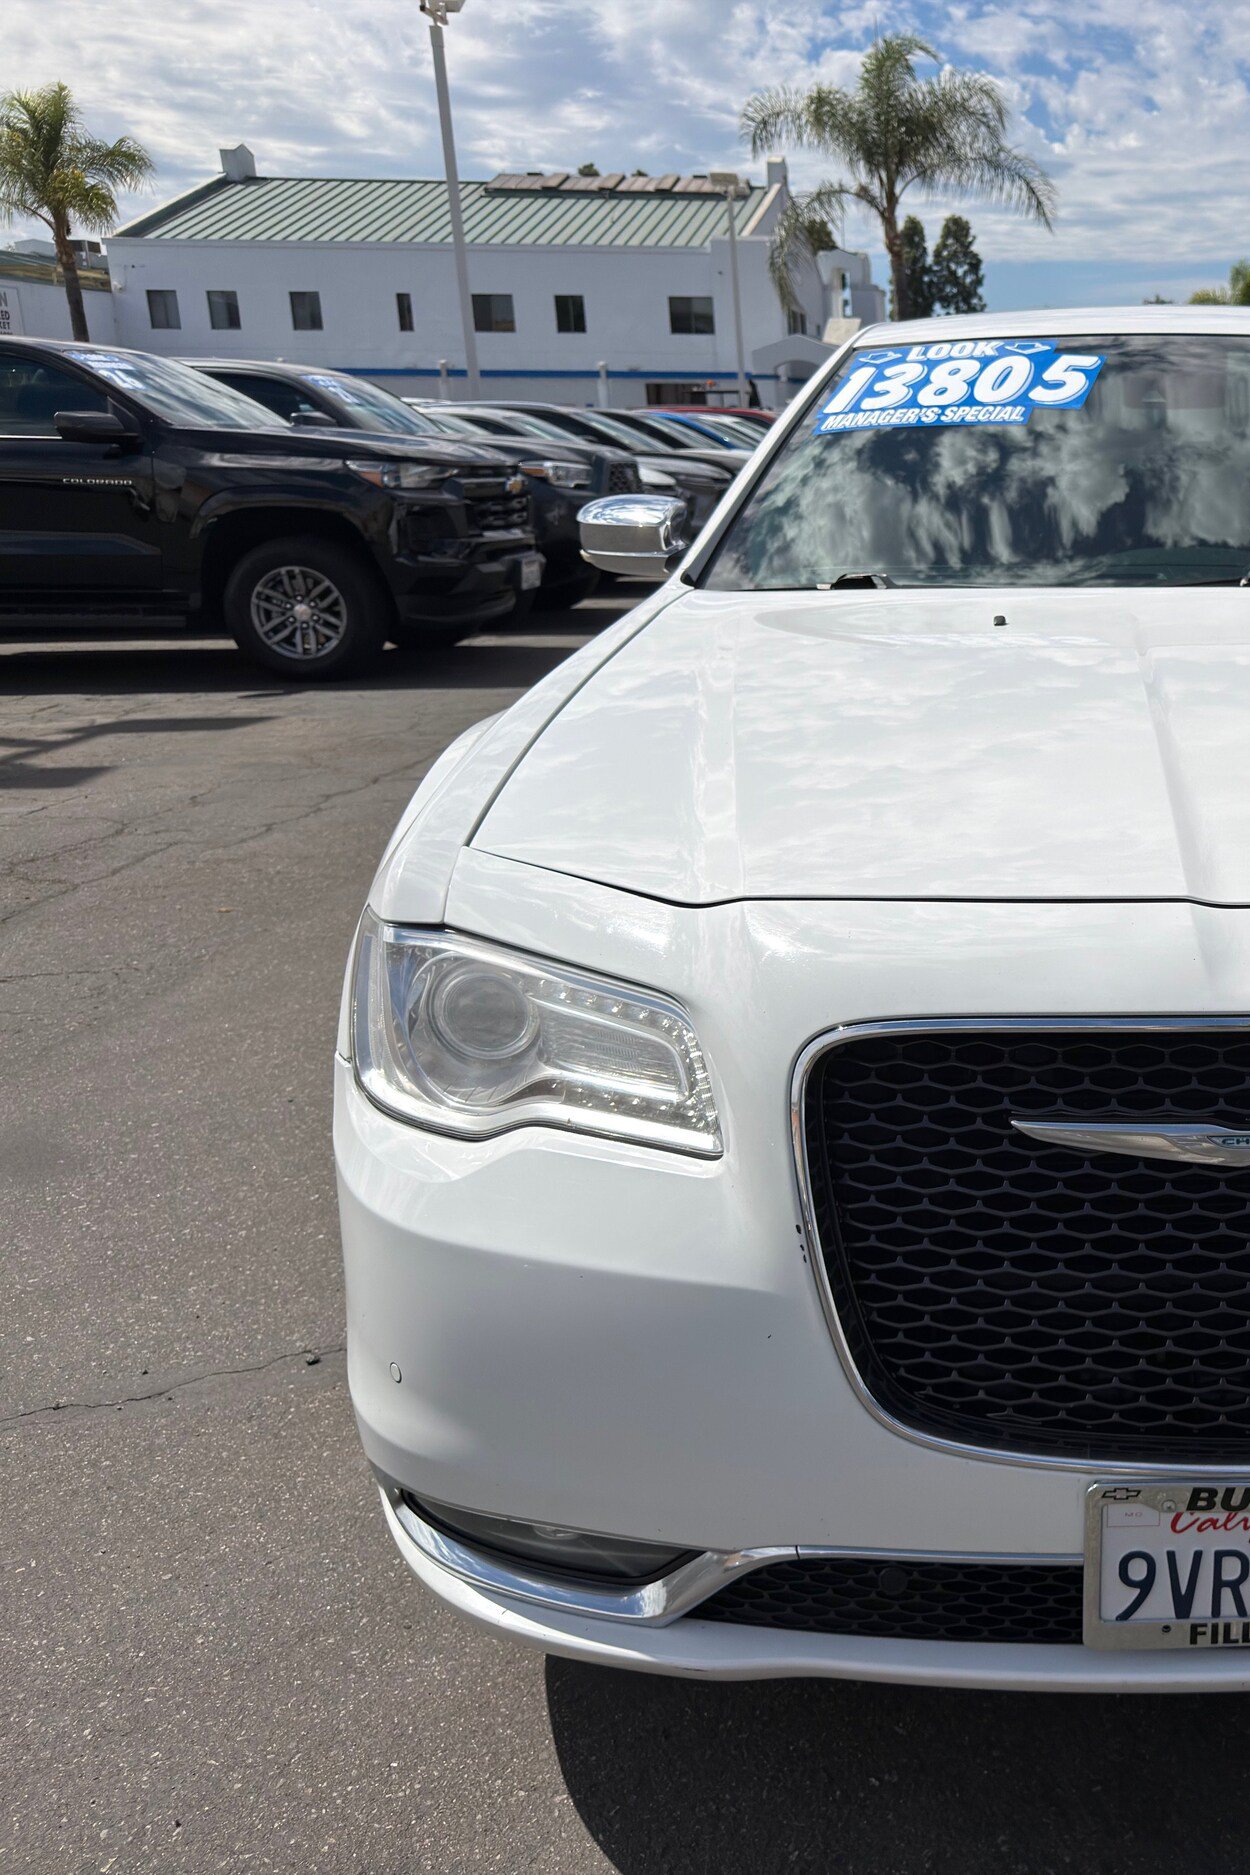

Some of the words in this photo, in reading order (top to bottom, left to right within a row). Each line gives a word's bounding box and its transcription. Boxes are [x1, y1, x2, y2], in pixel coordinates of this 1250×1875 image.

[905, 341, 1003, 362] LOOK
[822, 355, 1101, 414] 13805
[820, 407, 941, 432] MANAGER'S
[939, 405, 1027, 423] SPECIAL
[62, 477, 133, 486] COLORADO
